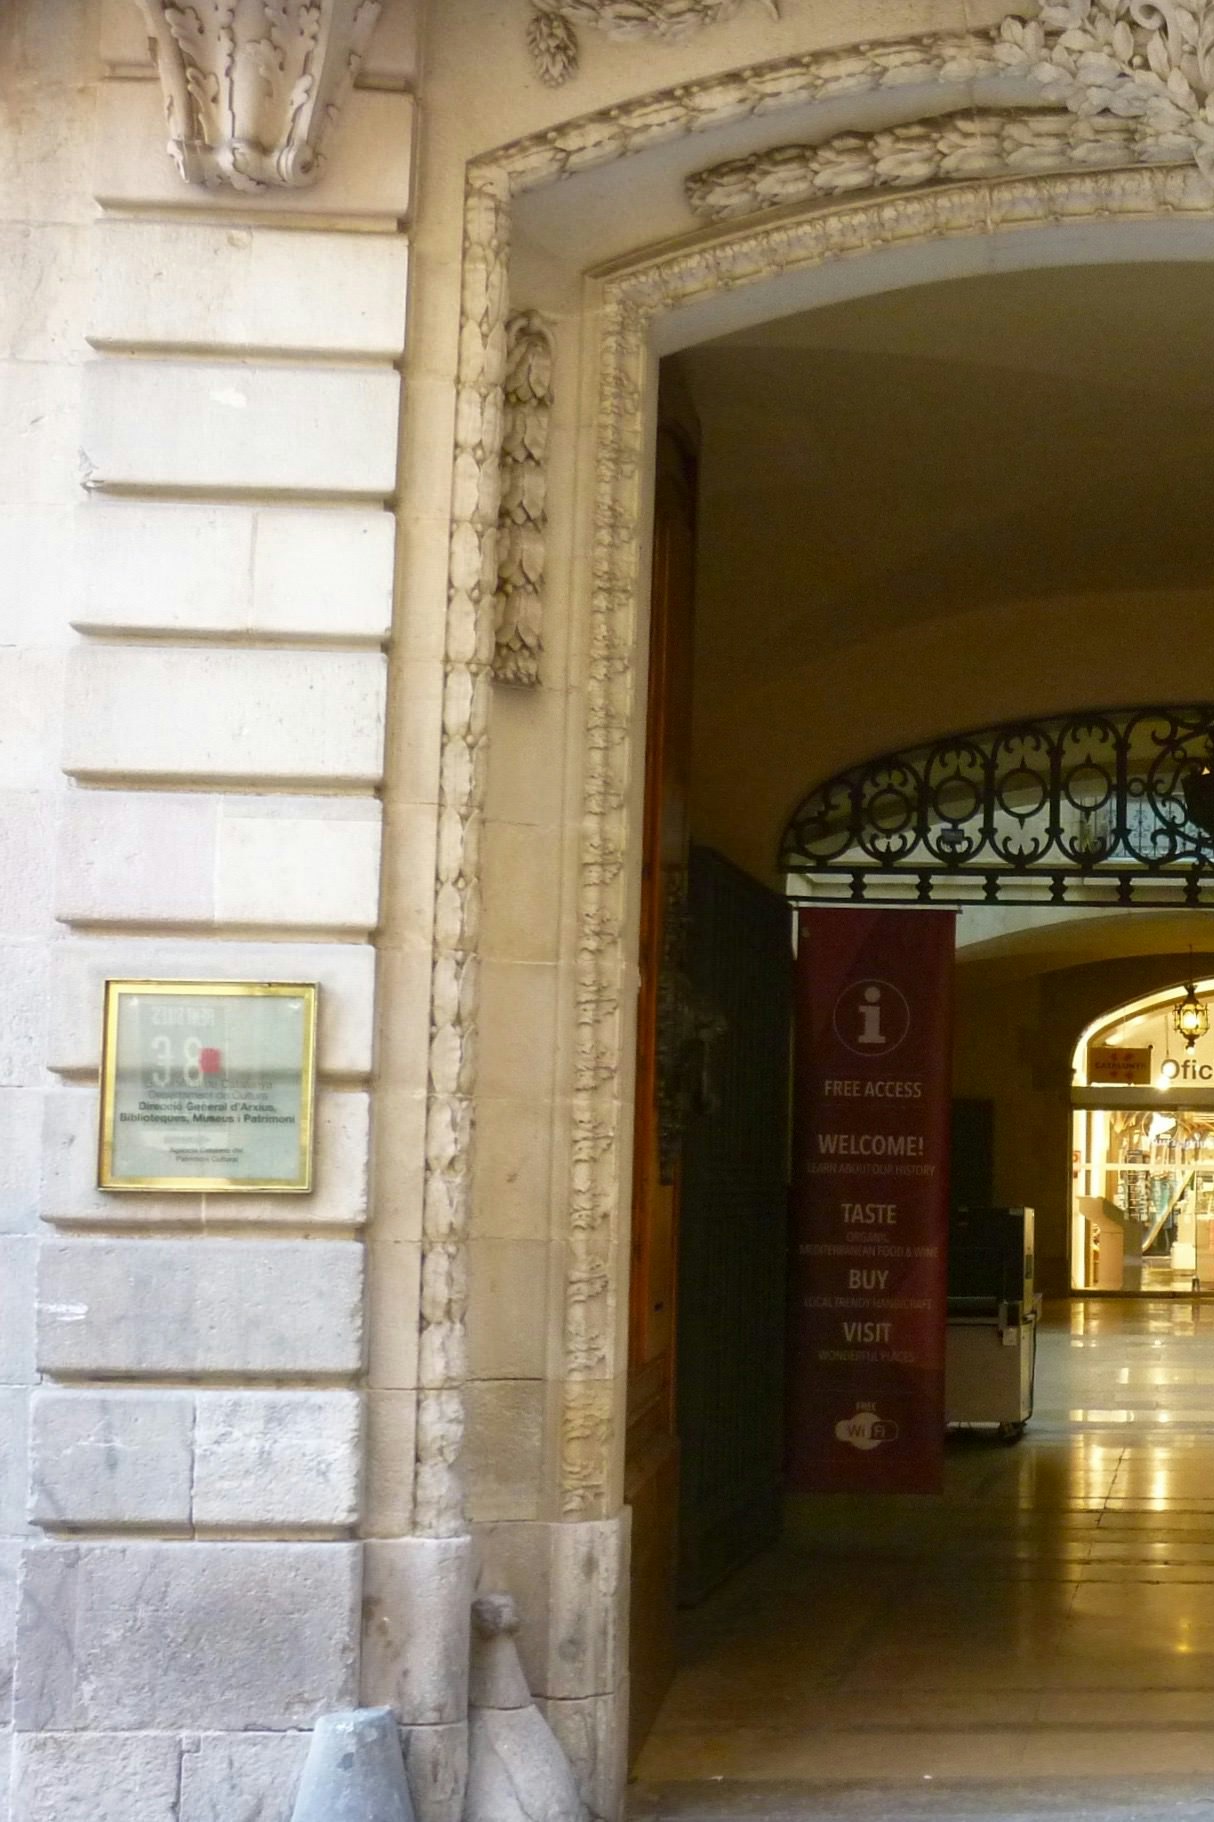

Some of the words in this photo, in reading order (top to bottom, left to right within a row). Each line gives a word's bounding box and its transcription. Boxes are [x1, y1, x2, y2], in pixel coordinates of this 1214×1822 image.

[823, 1080, 861, 1097] FREE
[863, 1081, 922, 1098] ACCESS
[186, 1101, 227, 1112] General
[192, 1113, 234, 1123] Museus
[243, 1112, 295, 1124] Patrimoni
[818, 1134, 924, 1157] WELCOME!
[895, 1164, 935, 1177] HISTORY
[840, 1203, 897, 1225] TASTE
[848, 1269, 889, 1290] BUY
[843, 1321, 892, 1343] VISIT
